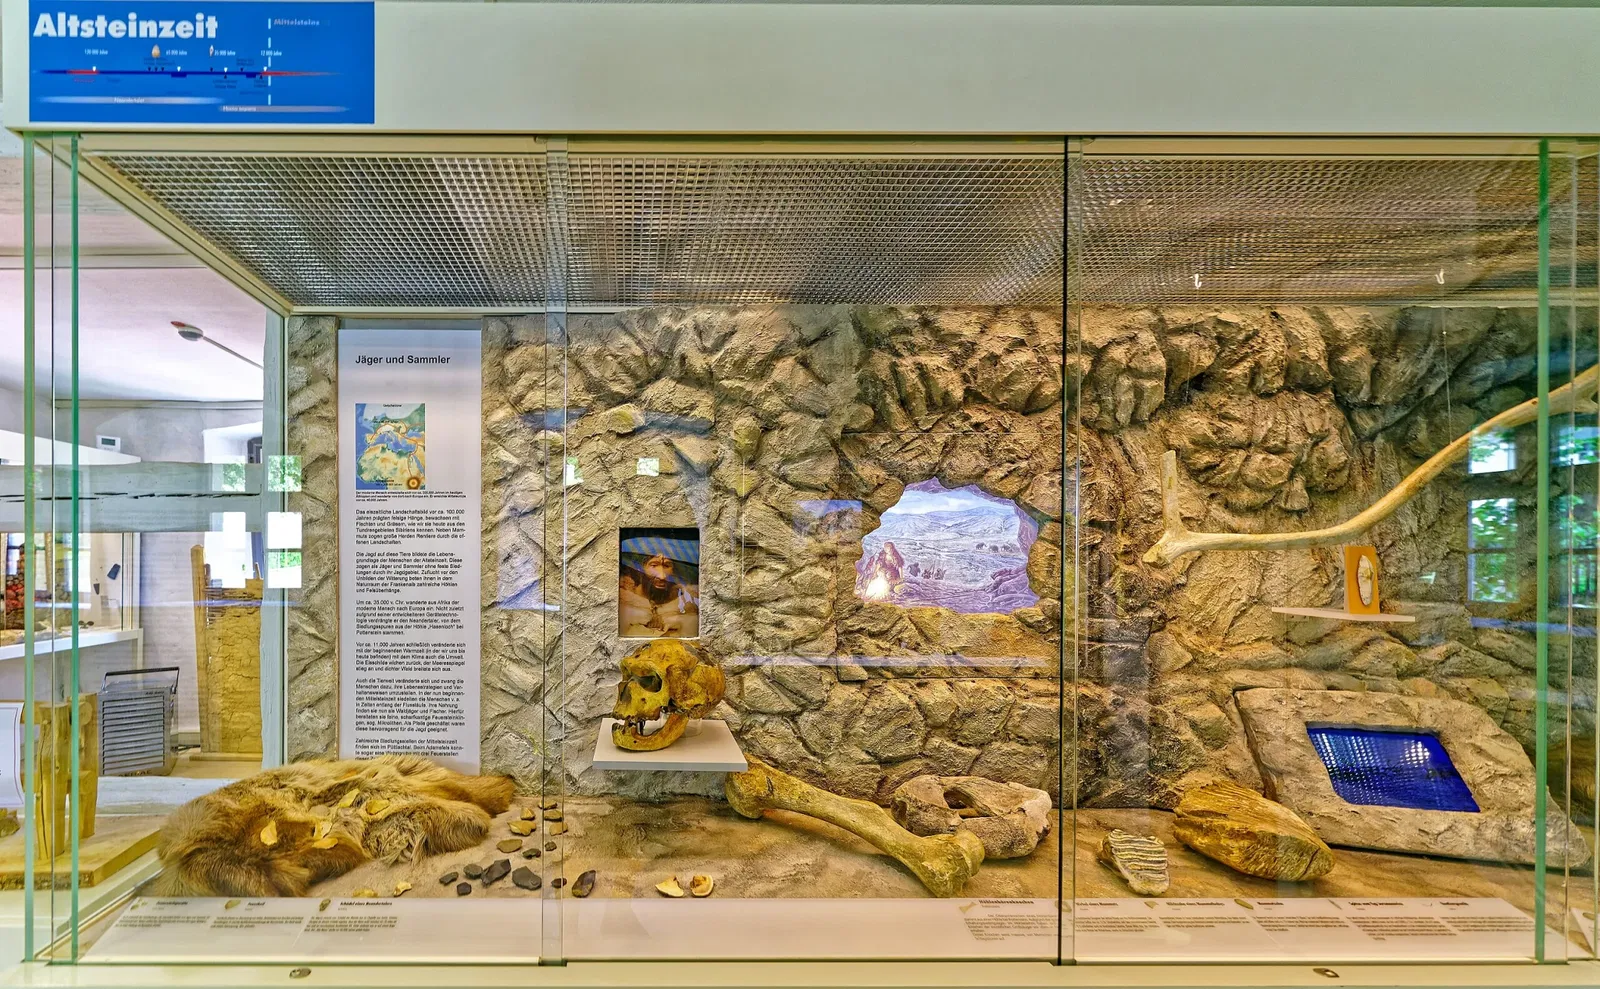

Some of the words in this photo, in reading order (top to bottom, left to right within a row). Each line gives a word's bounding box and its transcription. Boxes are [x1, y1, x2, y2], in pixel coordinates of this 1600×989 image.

[33, 12, 218, 39] Altsteinzeit
[355, 354, 383, 366] Jäger
[385, 355, 404, 364] und
[407, 354, 451, 364] Sammler
